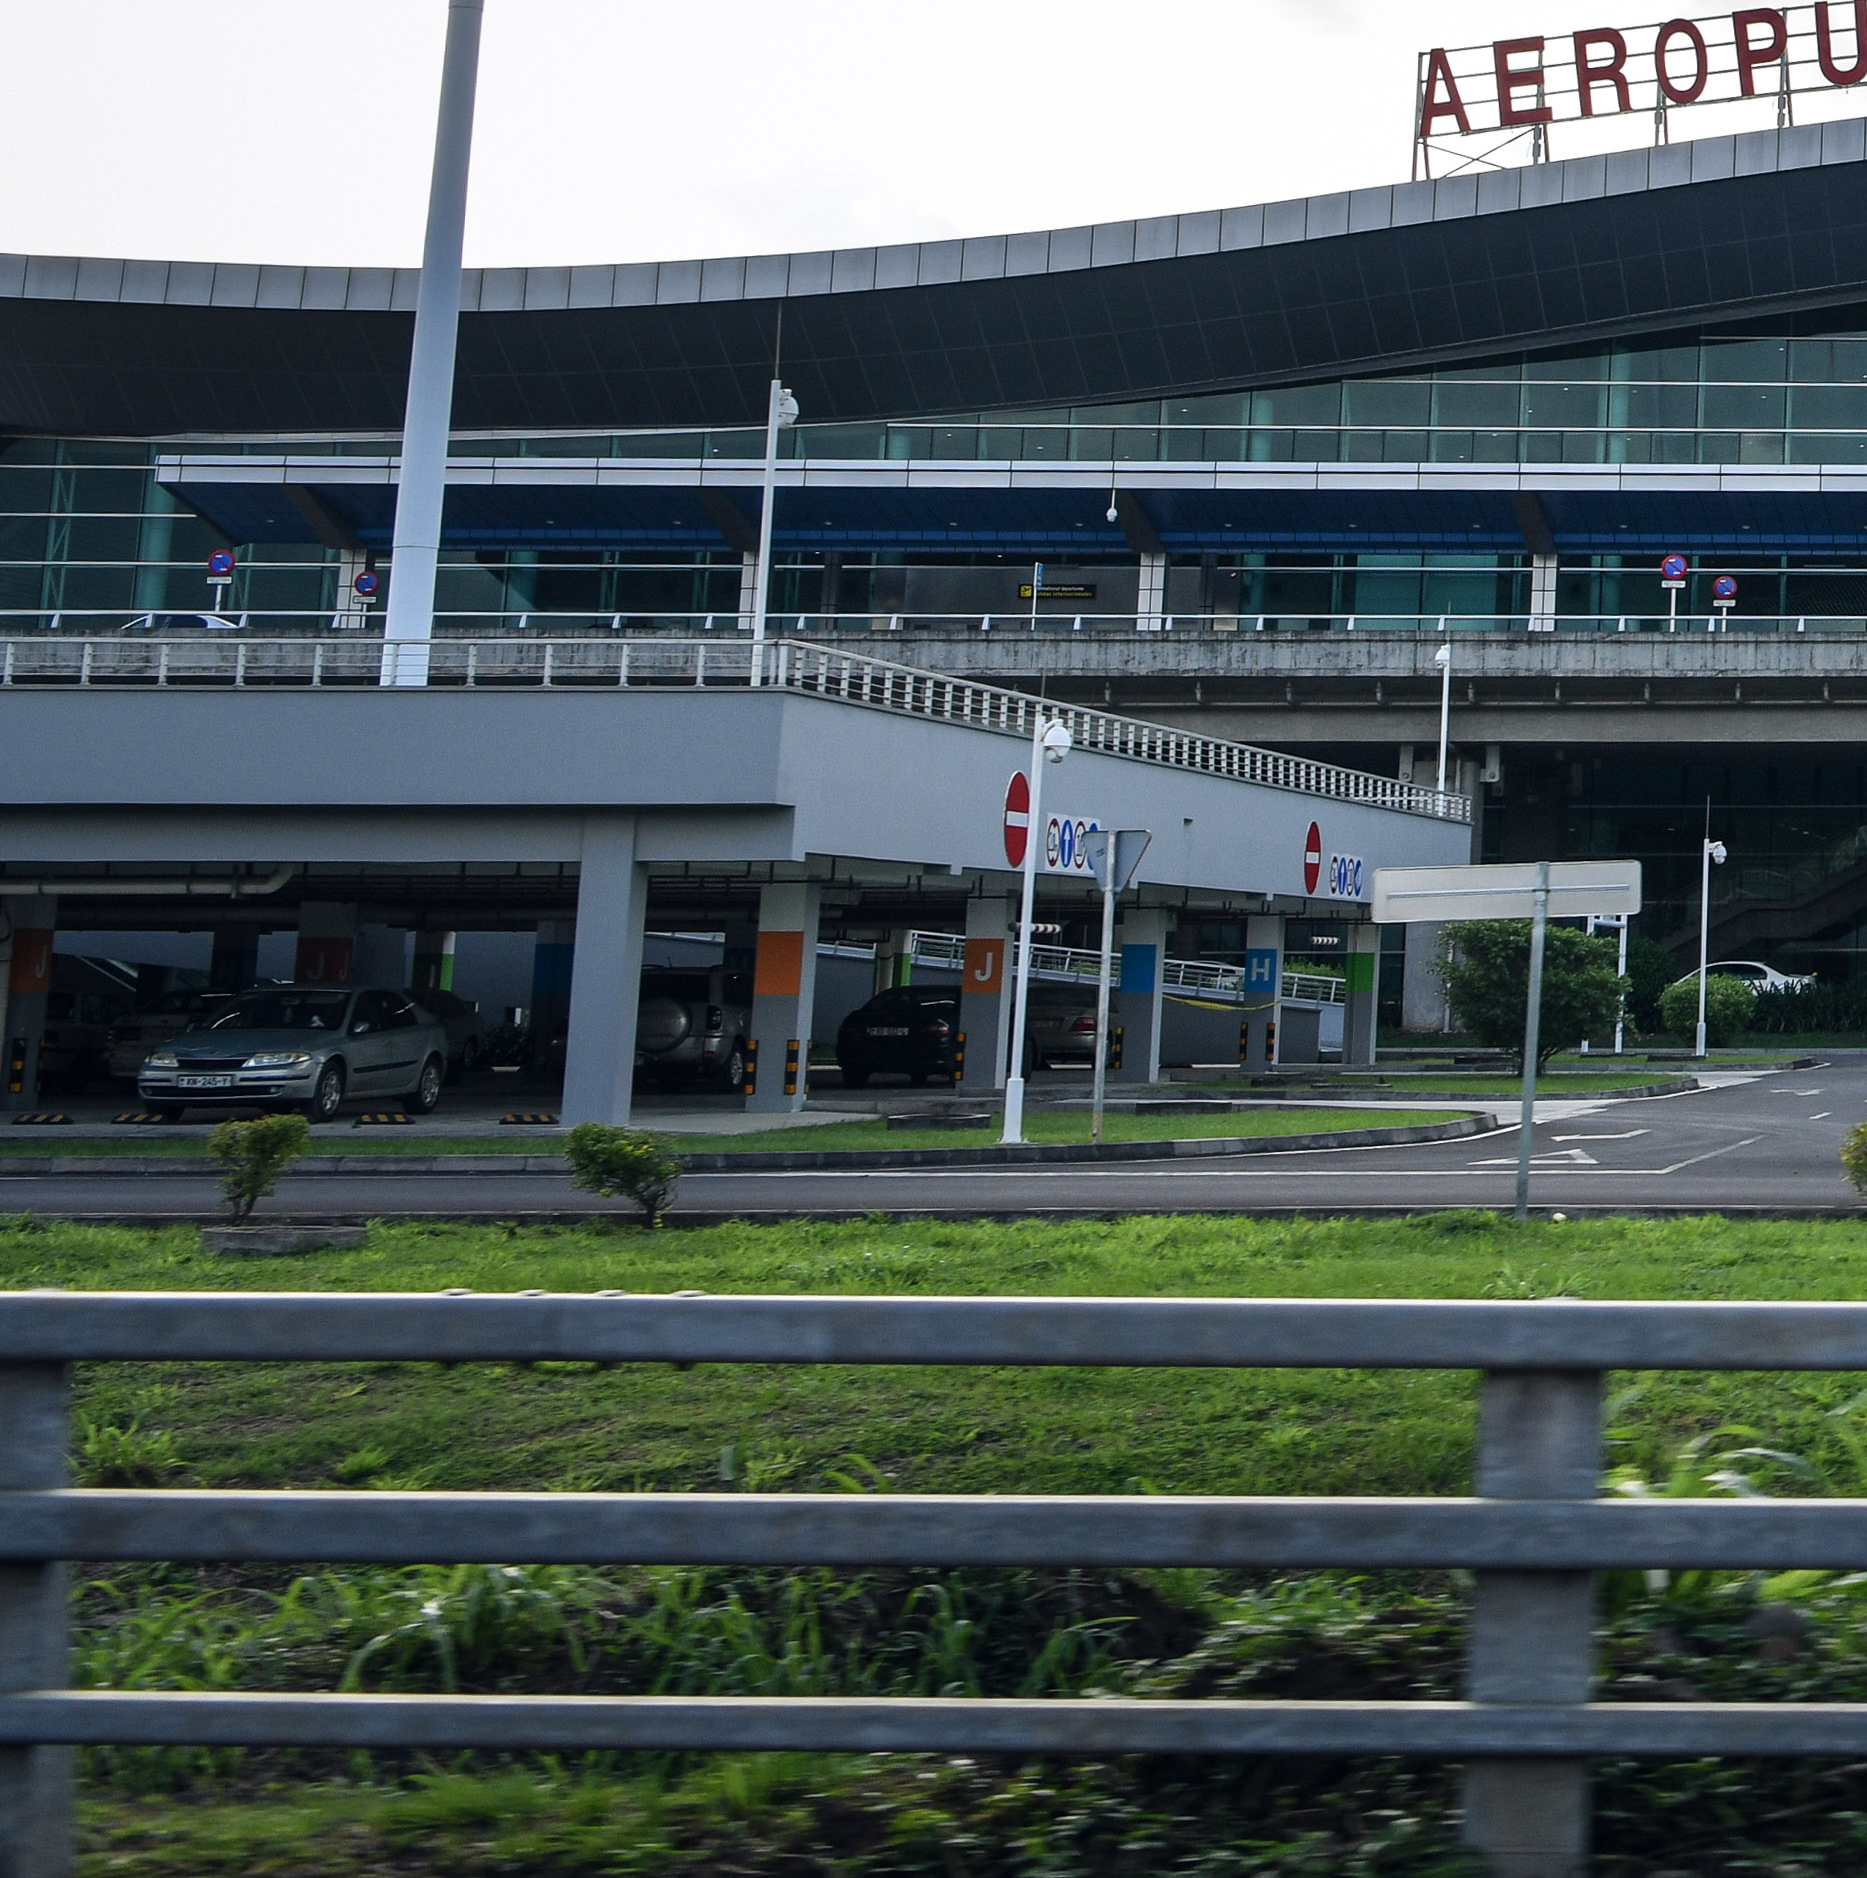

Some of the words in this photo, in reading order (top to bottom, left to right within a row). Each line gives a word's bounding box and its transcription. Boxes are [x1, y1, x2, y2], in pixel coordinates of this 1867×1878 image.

[36, 946, 47, 979] J
[974, 951, 993, 982] J
[1251, 957, 1270, 983] H
